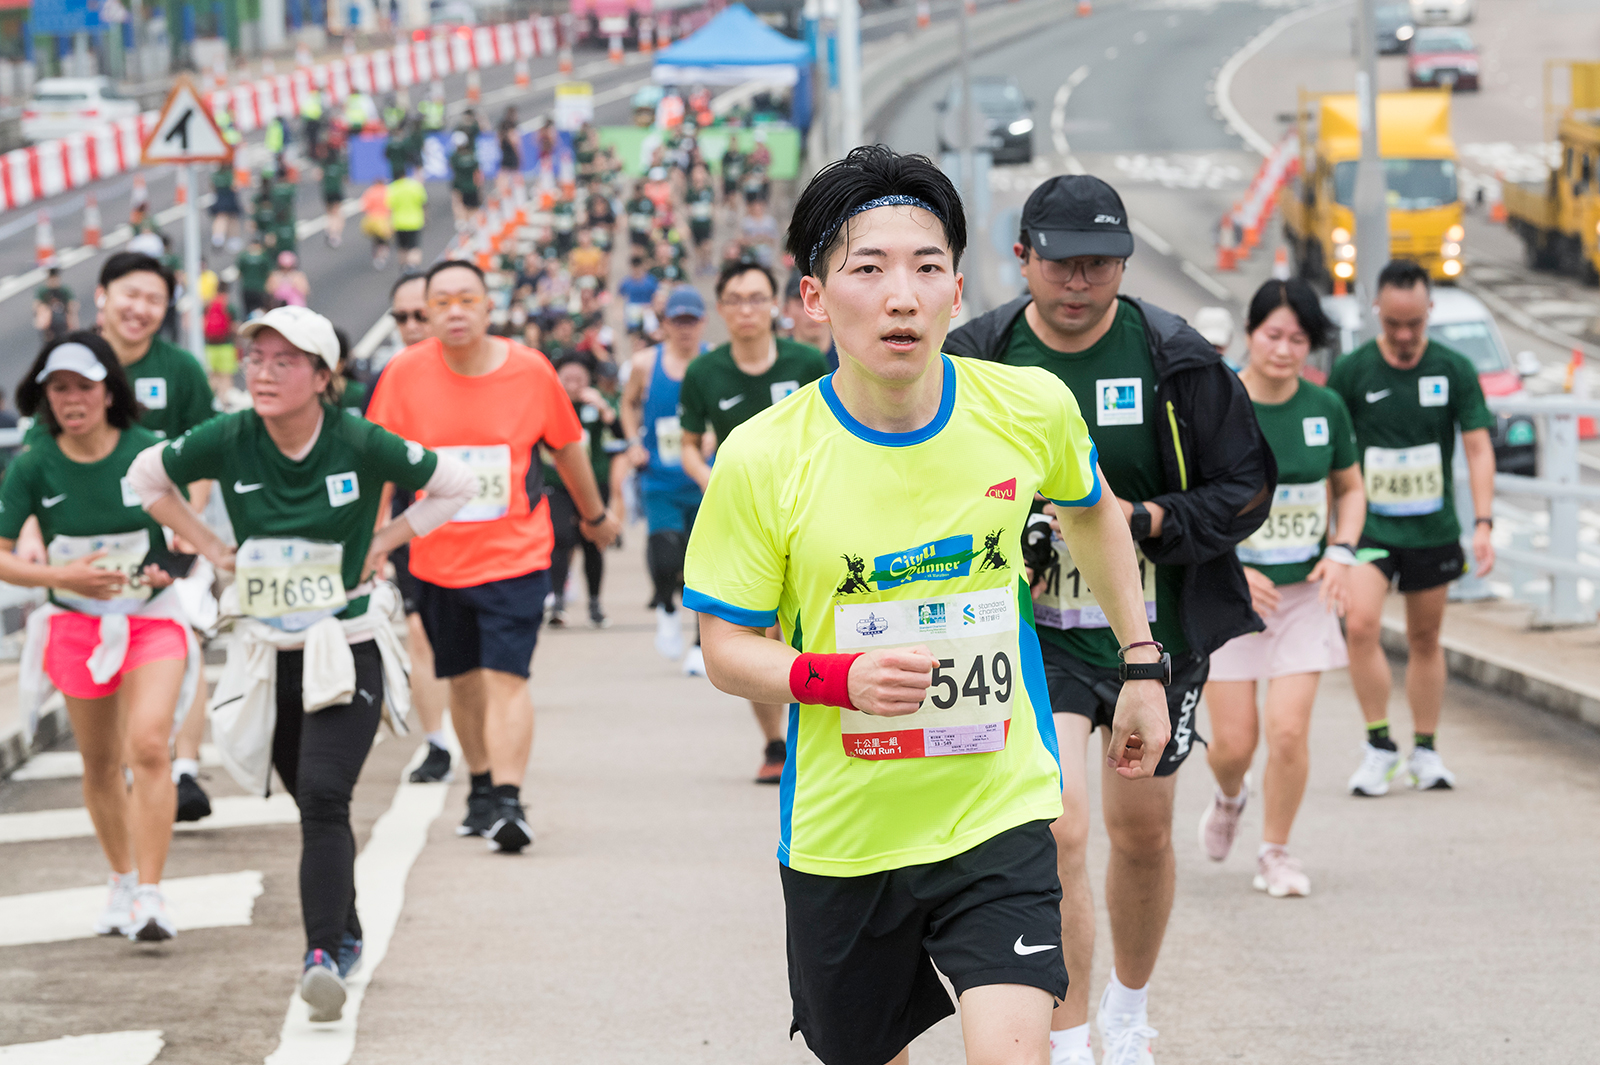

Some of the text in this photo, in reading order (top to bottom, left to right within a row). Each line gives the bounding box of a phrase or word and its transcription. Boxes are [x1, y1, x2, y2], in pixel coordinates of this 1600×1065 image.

[989, 488, 1013, 500] CityU
[1263, 511, 1321, 539] 3562
[901, 560, 960, 583] Runner
[247, 576, 334, 607] P1669
[978, 601, 1005, 609] standard
[979, 606, 1007, 615] chartered
[919, 651, 1012, 710] 549
[854, 737, 898, 748] 十公里一組
[854, 748, 876, 756] 10KM
[878, 747, 895, 755] Run
